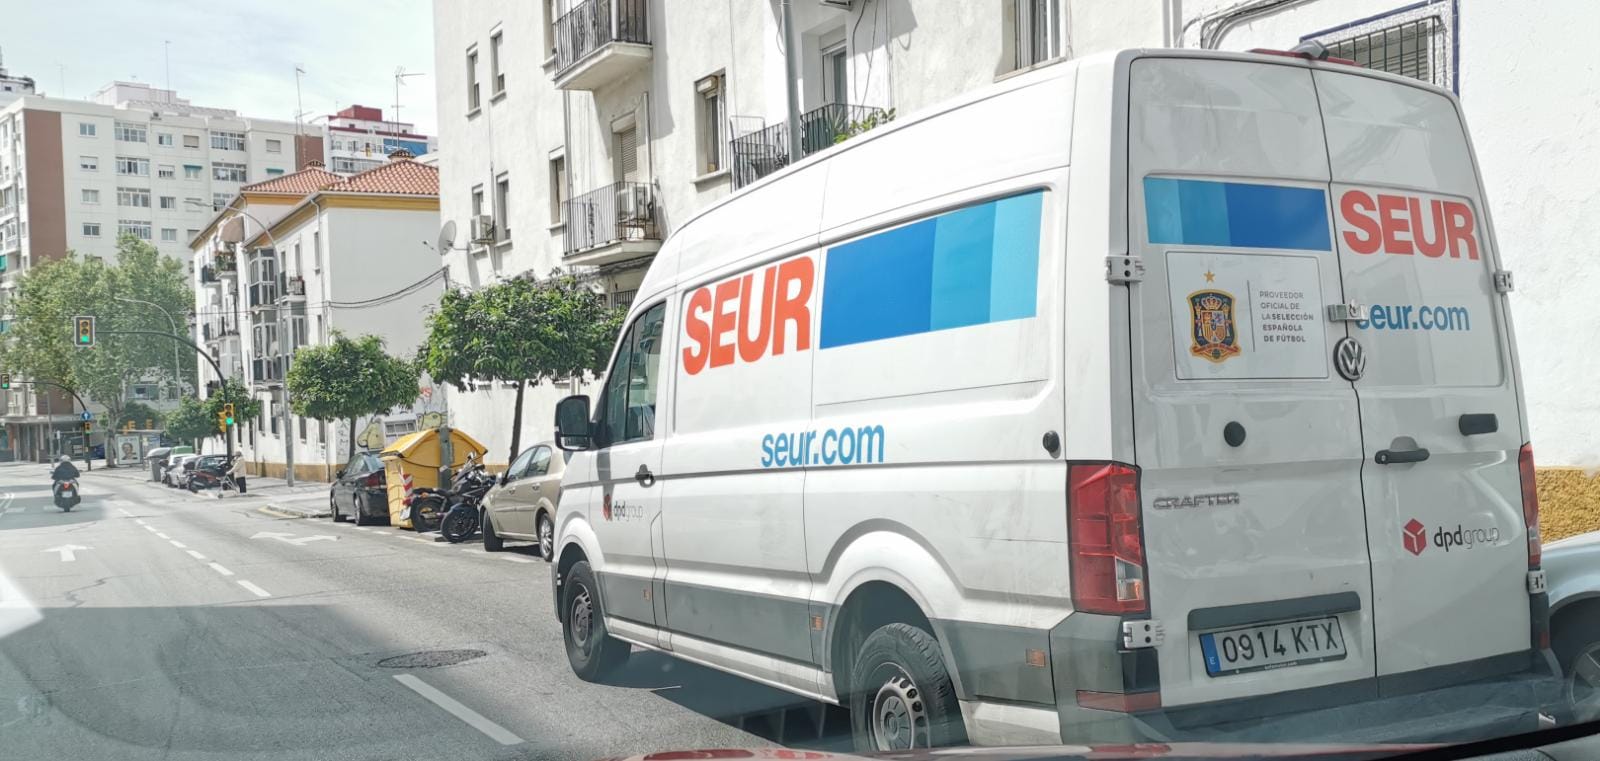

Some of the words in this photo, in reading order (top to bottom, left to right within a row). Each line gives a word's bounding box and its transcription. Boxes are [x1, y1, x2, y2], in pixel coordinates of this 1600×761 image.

[1340, 190, 1480, 260] SEUR
[1259, 290, 1304, 299] PROVEEDOR
[1260, 302, 1290, 310] OFICIAL
[1290, 302, 1301, 310] DE
[683, 256, 814, 375] SEUR
[1272, 312, 1314, 321] SELECCIÓN
[1262, 323, 1303, 331] ESPAÑOLA
[761, 424, 885, 467] seur.com
[1153, 492, 1240, 510] CRAFTER
[1433, 523, 1500, 552] dpdgroup
[1222, 629, 1287, 663] 0914
[1291, 622, 1338, 654] KTX
[1209, 656, 1216, 665] E
